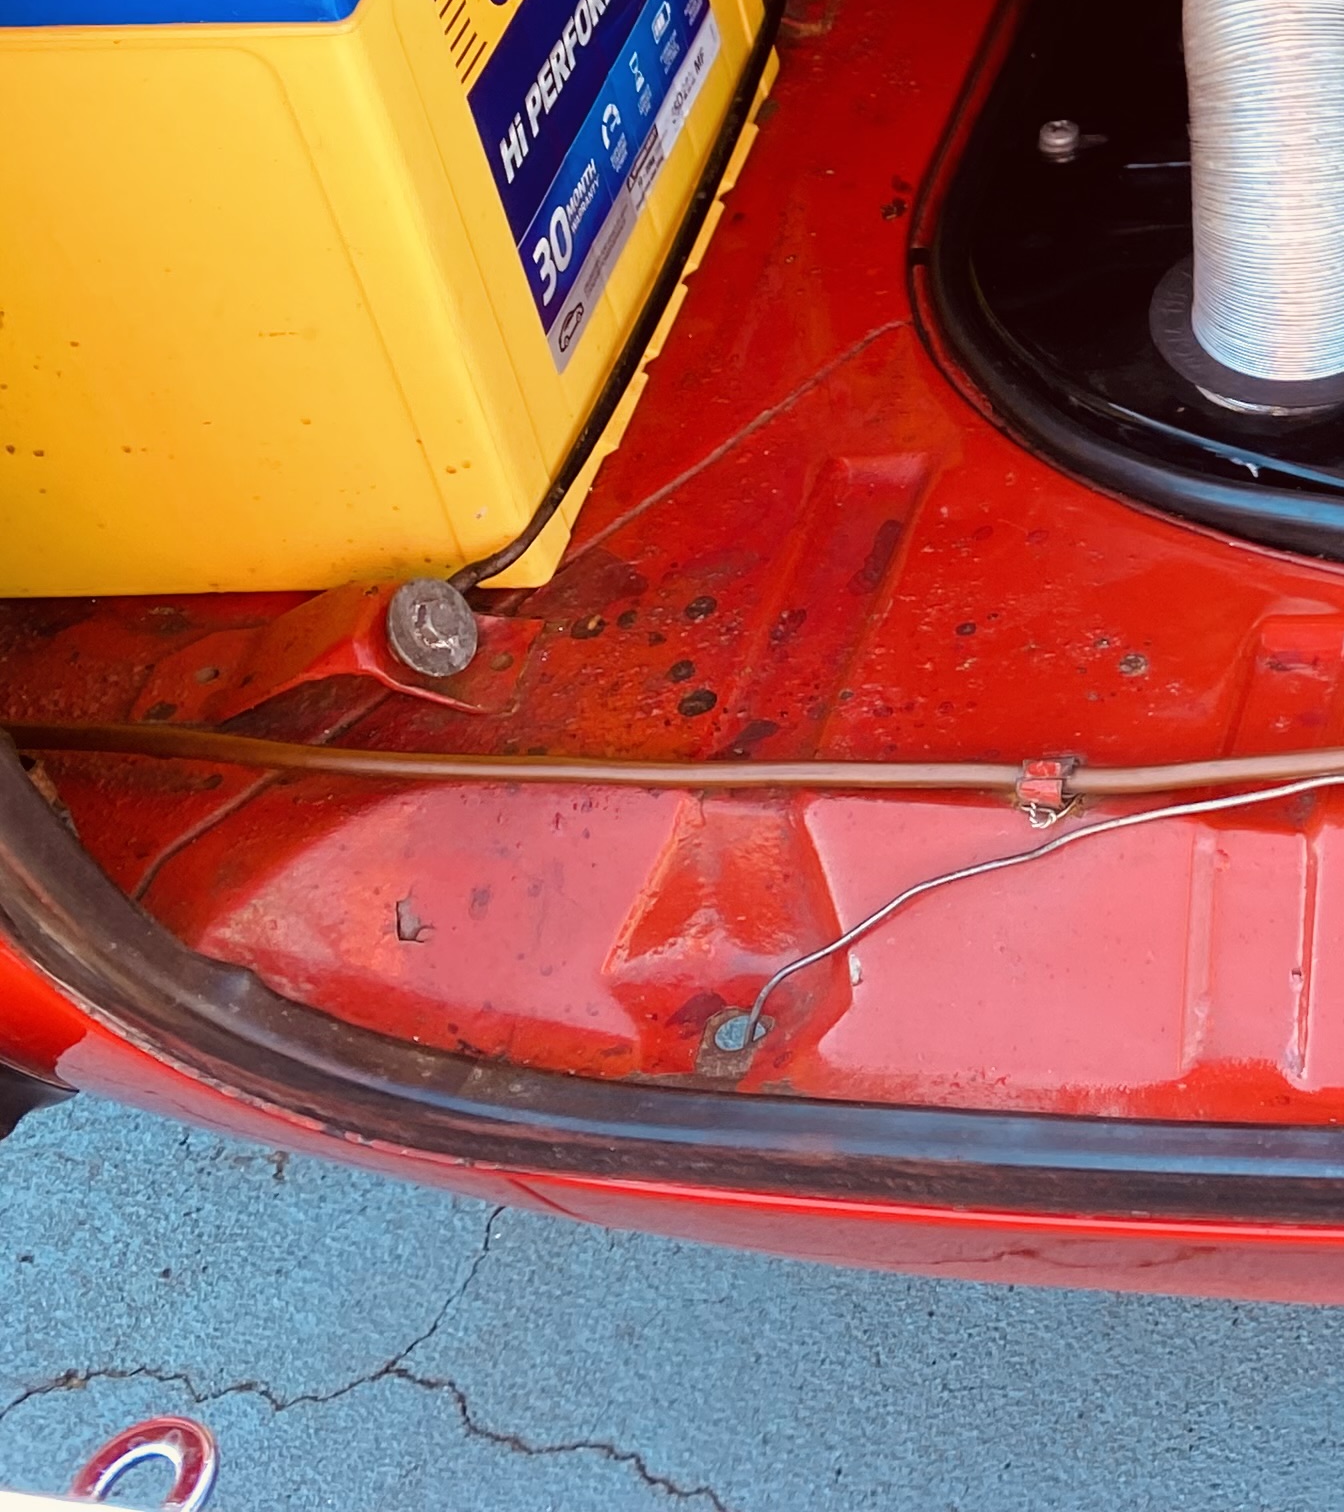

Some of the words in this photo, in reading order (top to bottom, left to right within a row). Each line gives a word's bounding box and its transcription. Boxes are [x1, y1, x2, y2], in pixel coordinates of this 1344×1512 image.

[499, 111, 529, 185] Hi
[565, 158, 597, 223] MONTH
[571, 173, 600, 234] WARRANTY
[532, 205, 573, 307] 30
